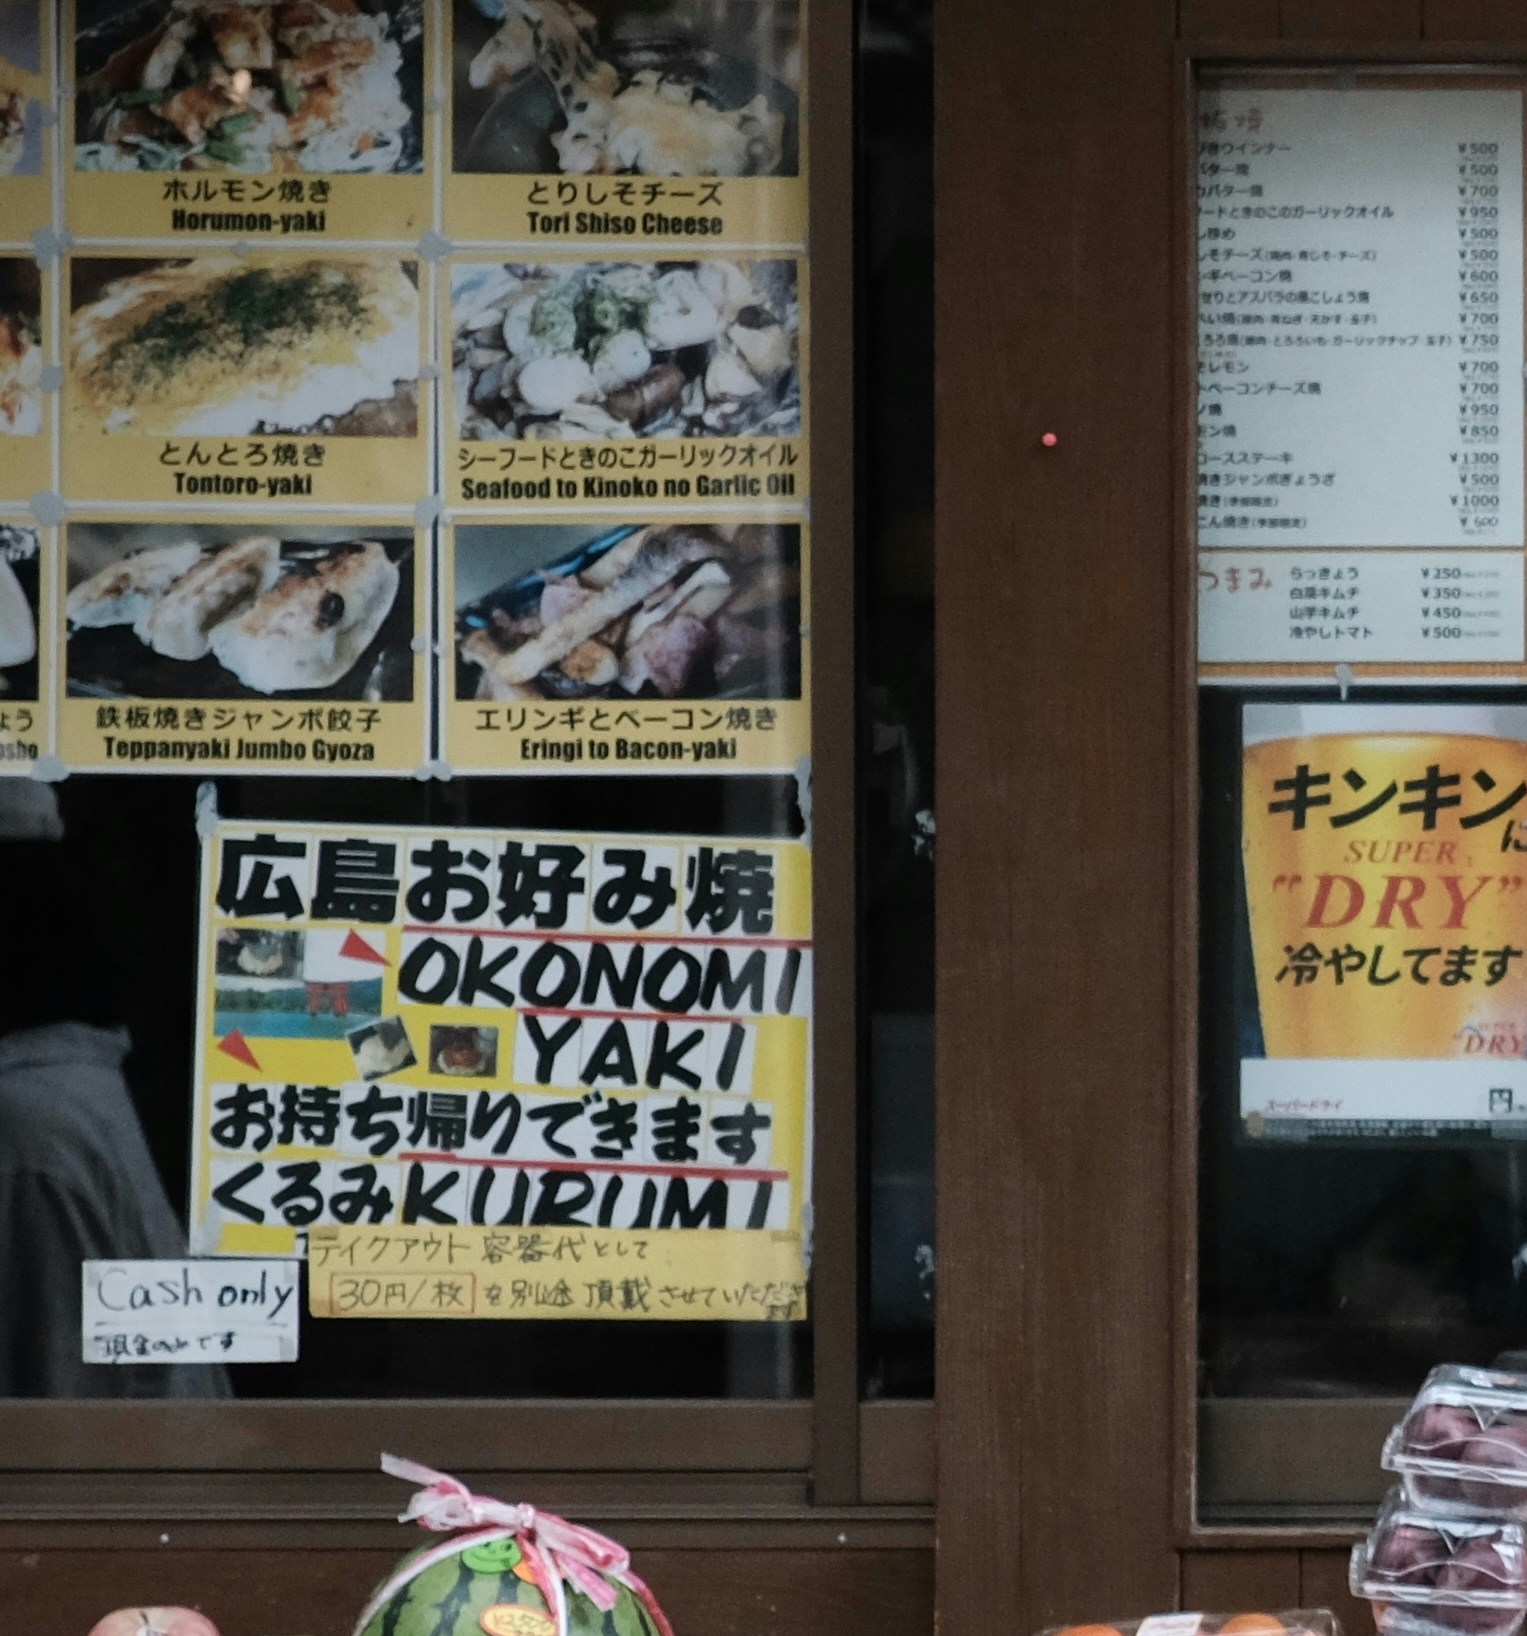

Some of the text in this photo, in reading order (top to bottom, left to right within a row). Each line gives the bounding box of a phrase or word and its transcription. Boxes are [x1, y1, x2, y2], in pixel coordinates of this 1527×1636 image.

[163, 178, 331, 203] ホルモン焼き
[527, 181, 723, 206] とりしそチーズ
[172, 209, 326, 233] Horumon-yaki
[526, 211, 723, 235] Tori Shiso Cheese
[159, 445, 326, 469] とんとろ焼き
[458, 444, 798, 470] シーフードときのこガーリックオイル
[174, 473, 312, 497] Tontoro-yaki
[462, 474, 795, 500] Seafood to Kinoko no Garlic Oil
[1290, 567, 1359, 580] らっきょう
[1289, 606, 1360, 620] 山芋キムチ
[1289, 626, 1373, 639] 冷やしトマト
[96, 706, 381, 732] 鉄板焼きジャンボ餃子
[475, 706, 777, 731] エリンギとベーコン焼き
[104, 736, 375, 763] Teppanyaki Jumbo Gyoza
[521, 737, 737, 762] Eringi to Bacon-yaki
[1268, 764, 1527, 831] キンキン
[1344, 841, 1459, 865] SUPER
[215, 833, 774, 934] 広島お好み焼
[398, 936, 803, 1015] OKONOMI
[1275, 943, 1522, 987] 冷やしてます
[524, 1014, 747, 1090] YAKI
[211, 1083, 772, 1165] お持ち帰りできます
[311, 1233, 648, 1266] テイクアウト 容器代として
[97, 1267, 294, 1320] Cash only
